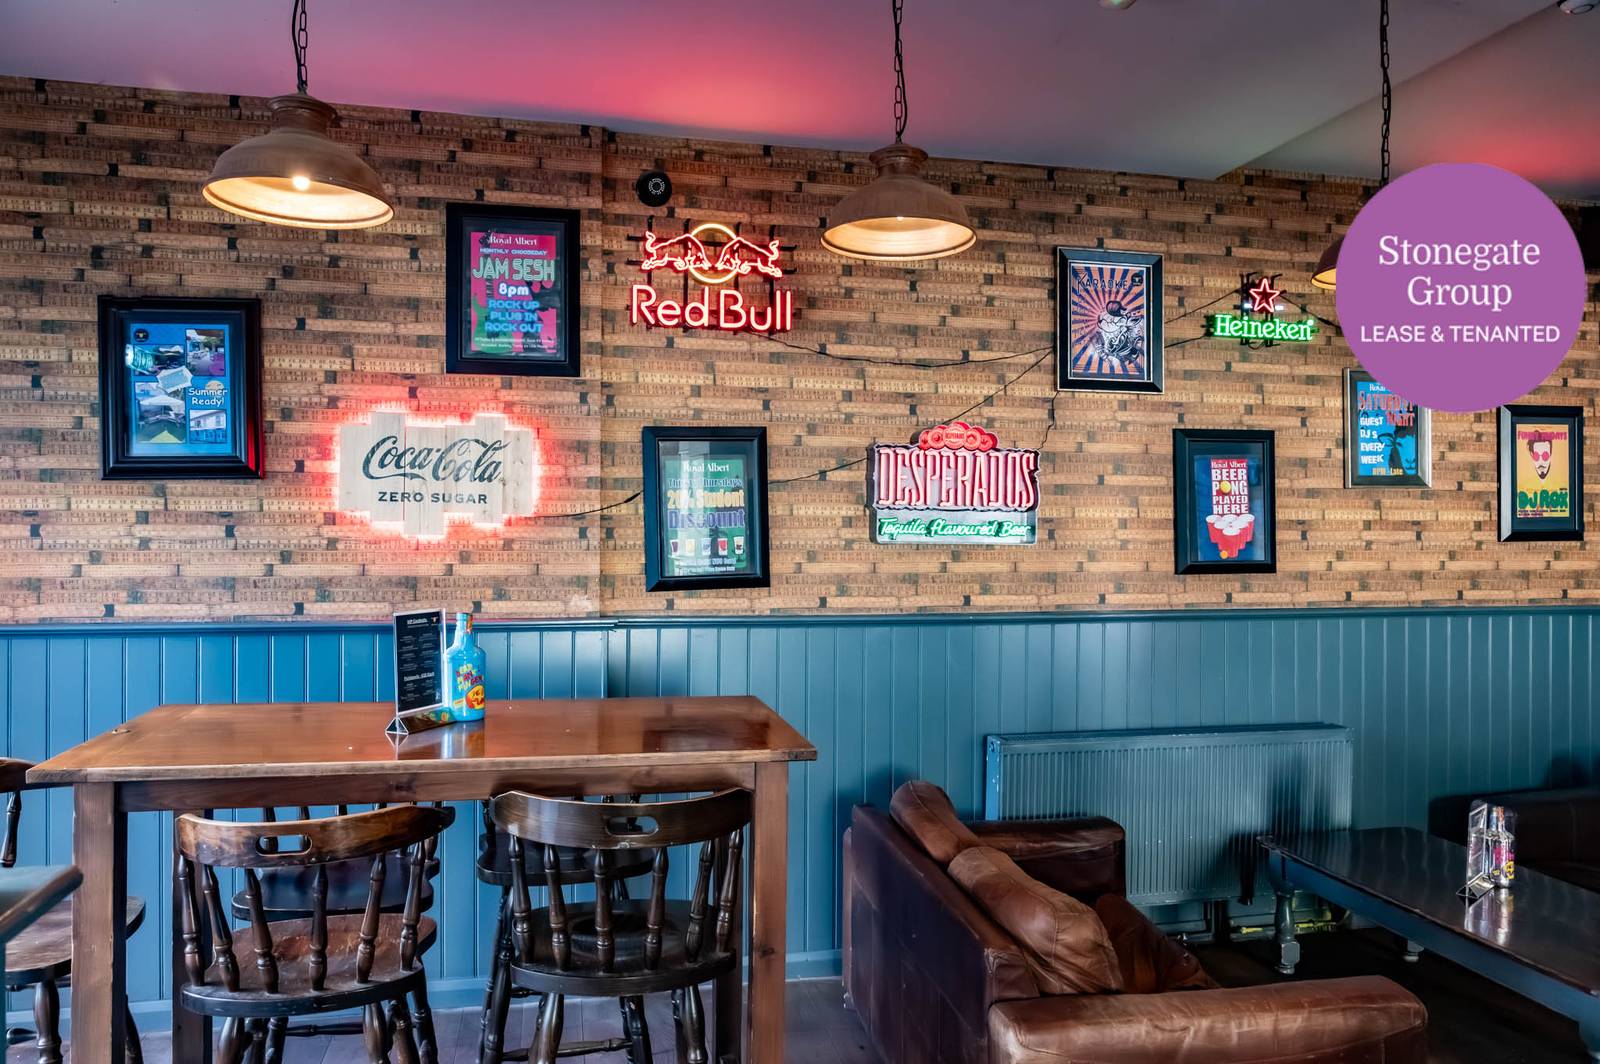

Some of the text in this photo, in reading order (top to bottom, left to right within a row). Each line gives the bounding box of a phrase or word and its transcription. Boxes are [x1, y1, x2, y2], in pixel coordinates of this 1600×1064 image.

[489, 235, 538, 247] Royal Albert
[472, 256, 555, 281] JAM SESH
[498, 282, 530, 298] 8pm
[1077, 273, 1128, 295] KARAOKE
[487, 299, 540, 311] ROCK UP
[631, 284, 792, 331] Red Bull
[524, 312, 538, 322] IN
[484, 322, 544, 334] ROCK OUT
[1214, 314, 1314, 341] Heineken
[188, 387, 228, 396] Summer
[191, 397, 225, 407] Ready!
[1360, 442, 1385, 452] EVERY
[1360, 454, 1384, 464] WEEK
[683, 462, 730, 474] Royal Albert
[1211, 468, 1247, 481] BEER
[878, 447, 1036, 509] DESPERADOS
[378, 491, 488, 504] ZERO SUGAR
[695, 488, 745, 508] Student
[1213, 495, 1248, 504] PLAYED
[1518, 491, 1538, 509] DJ
[1213, 504, 1249, 514] HERE
[667, 509, 746, 529] Discount
[879, 517, 928, 537] Tequila
[999, 520, 1031, 537] Beer
